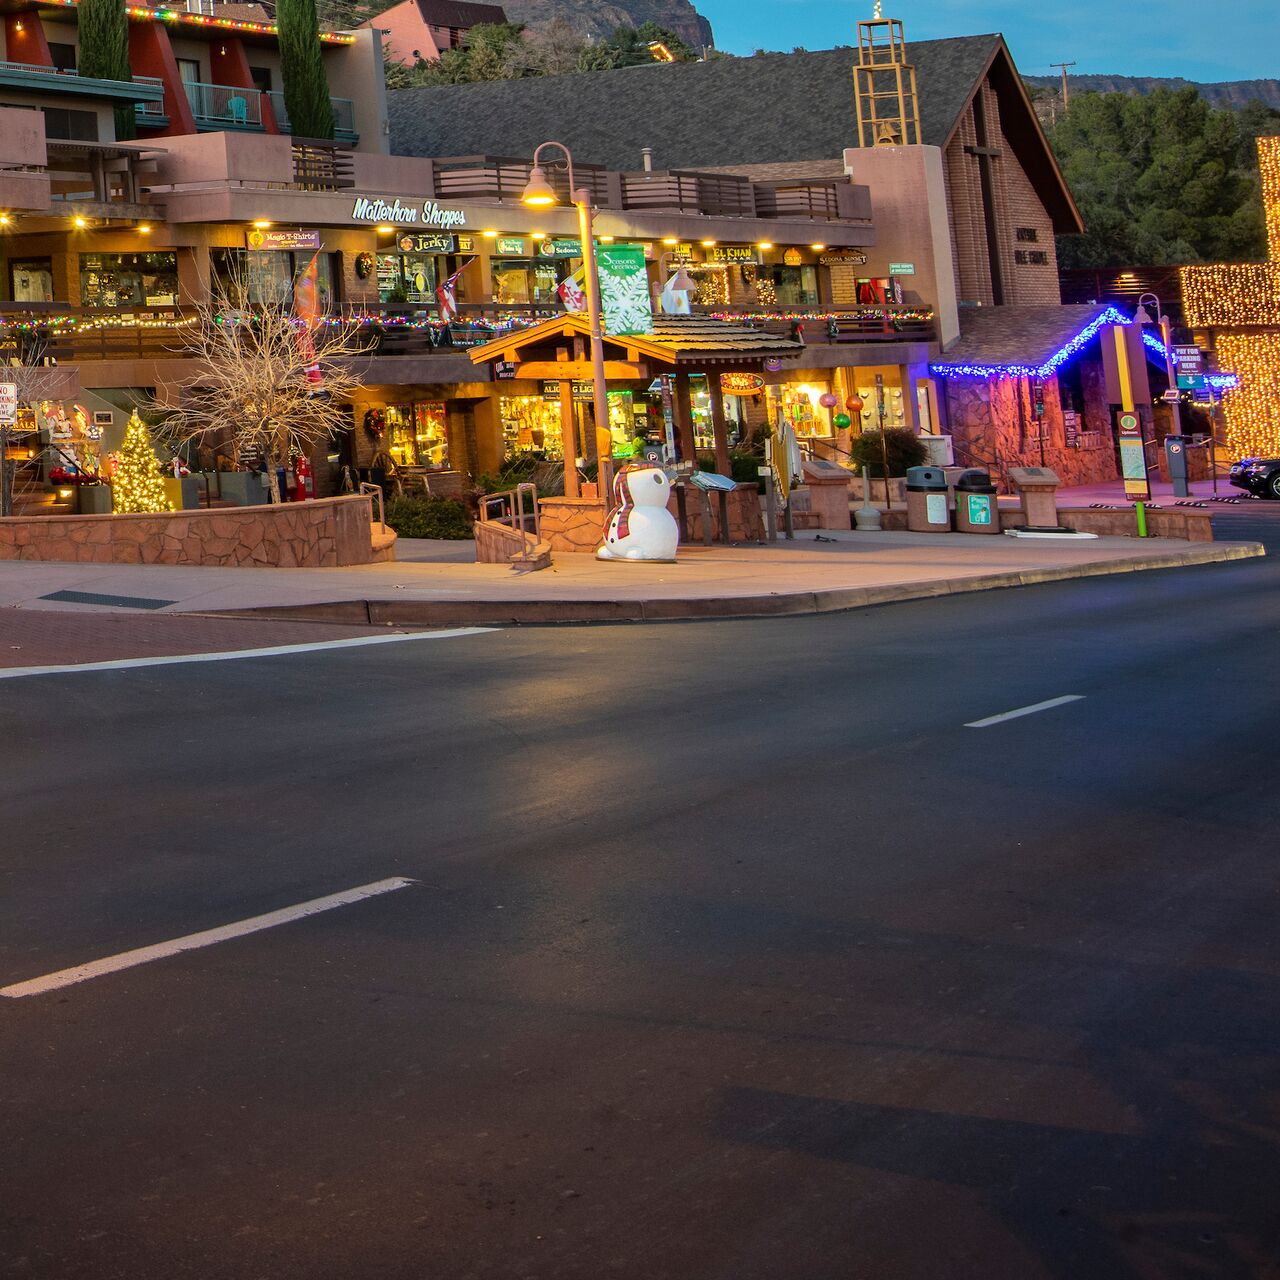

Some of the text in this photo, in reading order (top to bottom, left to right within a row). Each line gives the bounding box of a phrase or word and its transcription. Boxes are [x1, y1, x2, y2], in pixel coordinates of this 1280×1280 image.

[352, 198, 466, 229] Matterhorn Shoppes
[414, 237, 450, 252] Jerky
[602, 252, 636, 265] Seasons
[713, 248, 752, 257] EL KHAN
[819, 255, 867, 264] SEDONA SUNSET
